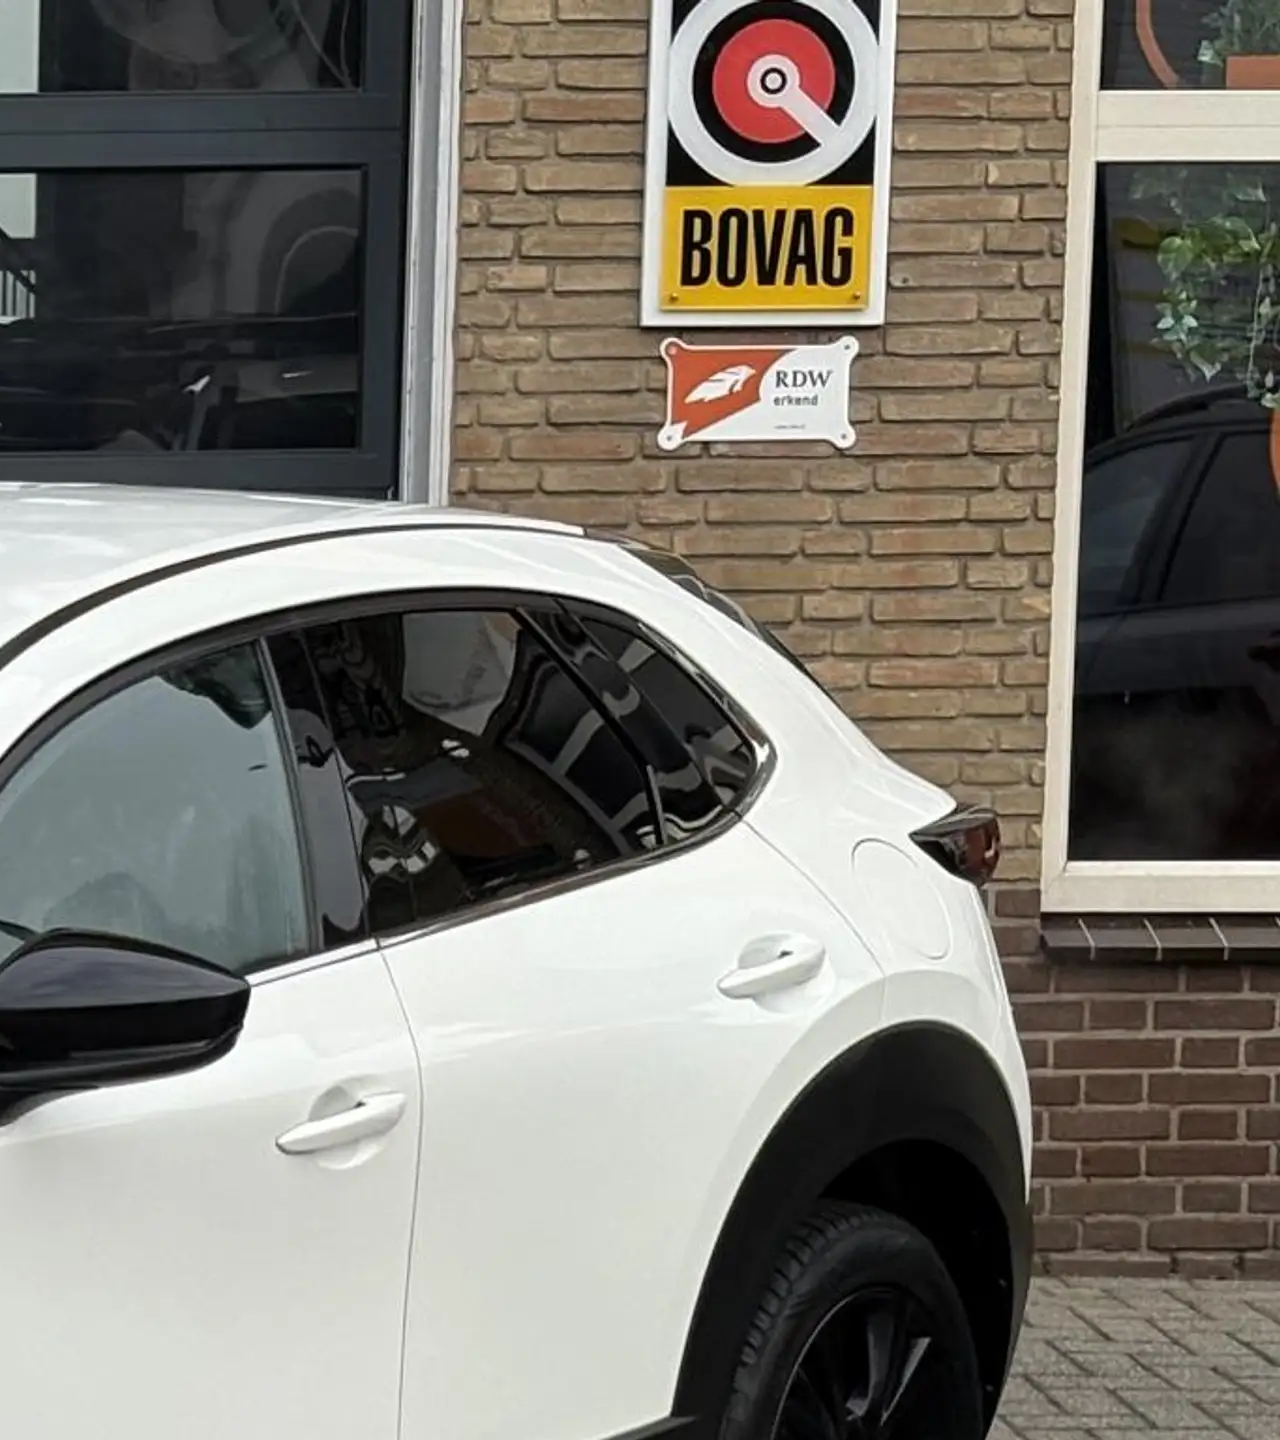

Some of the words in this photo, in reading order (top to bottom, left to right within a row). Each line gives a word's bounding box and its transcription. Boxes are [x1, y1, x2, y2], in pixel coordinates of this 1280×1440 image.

[680, 207, 855, 288] BOVAG
[775, 369, 834, 389] RDW
[773, 394, 819, 407] erkend
